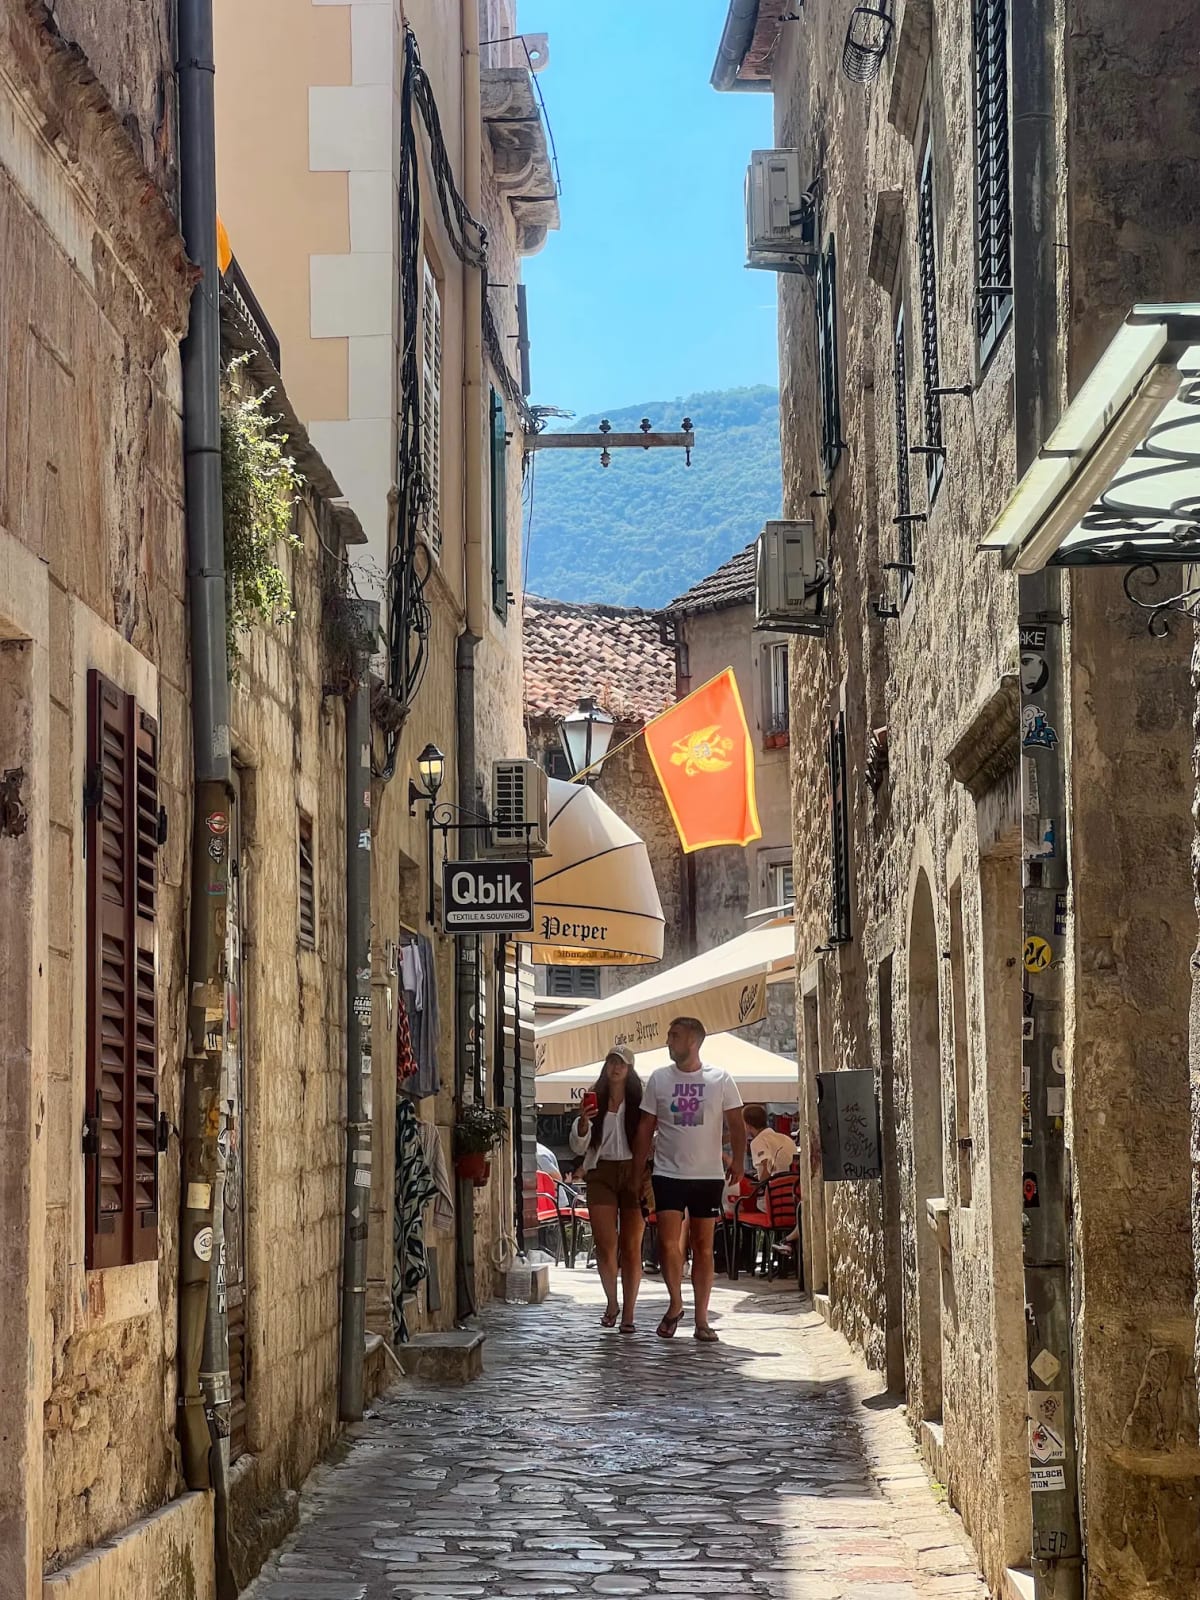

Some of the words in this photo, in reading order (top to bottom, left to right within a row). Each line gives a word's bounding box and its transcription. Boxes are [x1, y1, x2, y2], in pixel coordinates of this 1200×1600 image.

[452, 872, 523, 904] Qbik
[452, 913, 479, 921] TEXTILE
[486, 912, 525, 920] SOUVENIRS
[539, 915, 608, 941] Perper
[672, 1083, 705, 1097] JUST
[678, 1097, 700, 1112] DO
